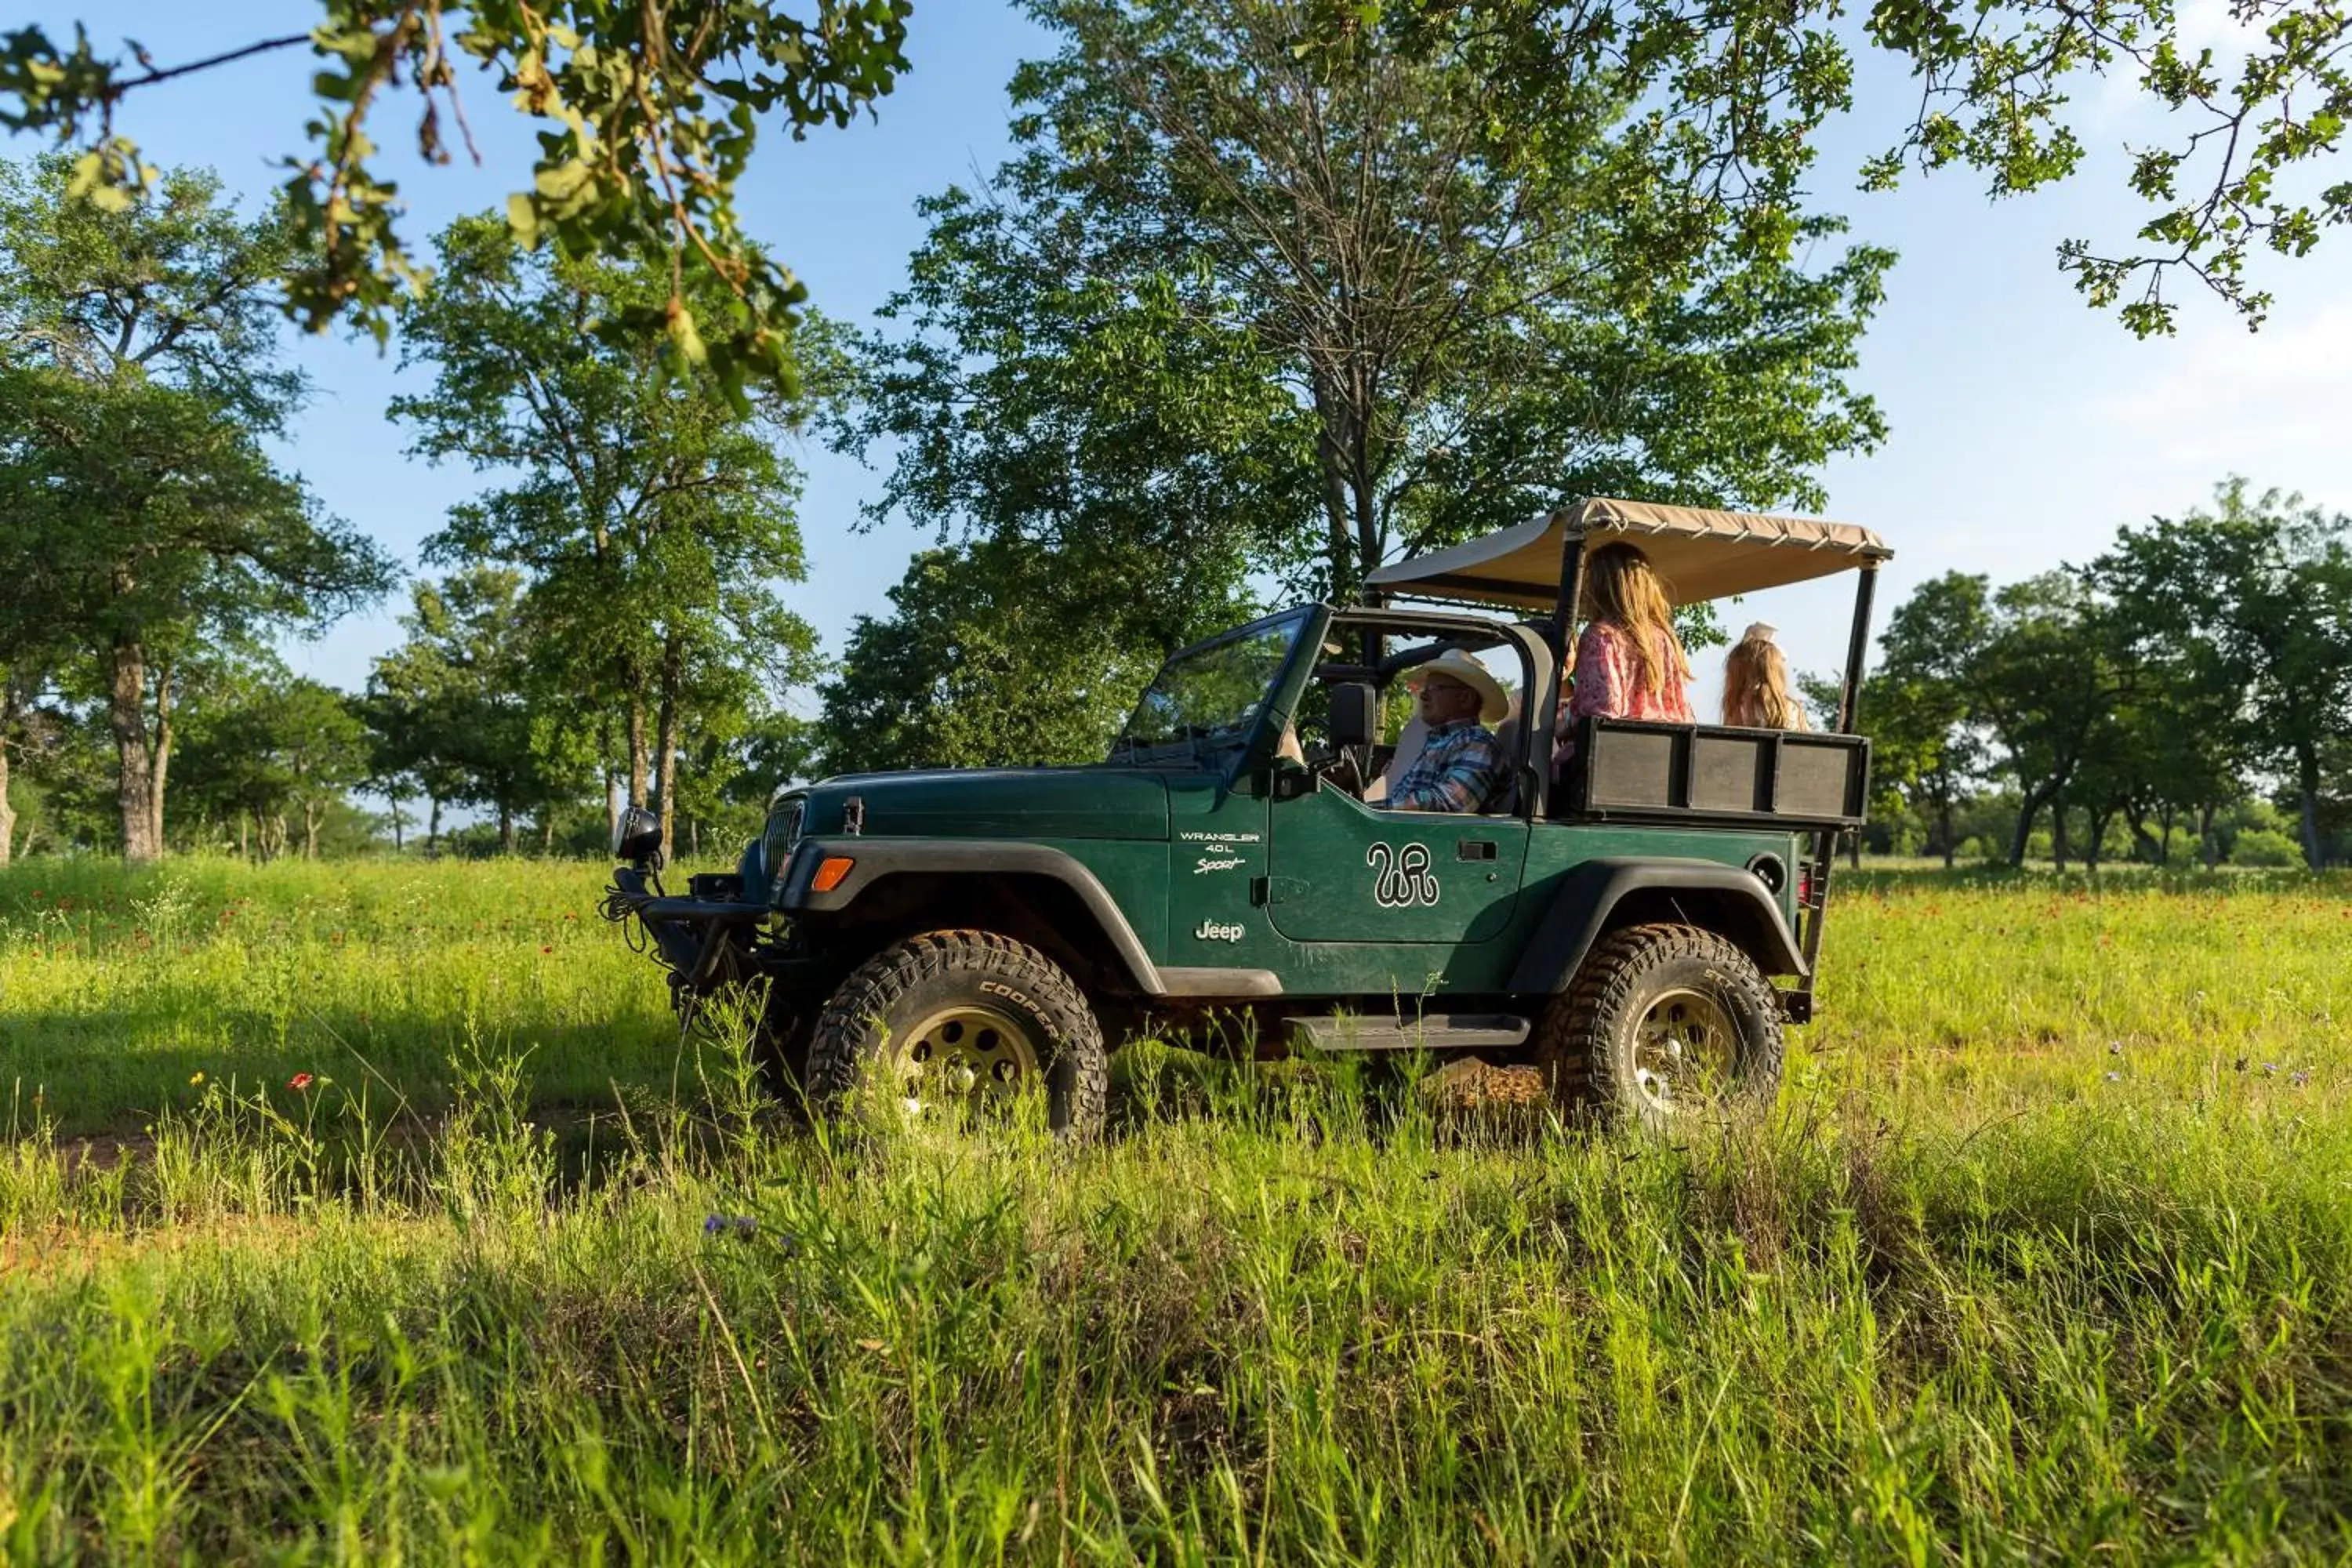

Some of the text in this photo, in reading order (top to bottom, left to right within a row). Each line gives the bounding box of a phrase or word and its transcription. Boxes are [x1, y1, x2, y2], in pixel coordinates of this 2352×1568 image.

[1180, 832, 1260, 843] WRANGLER
[1193, 857, 1246, 874] Sport
[1196, 921, 1243, 943] Jeep
[979, 981, 1059, 1039] COOPER
